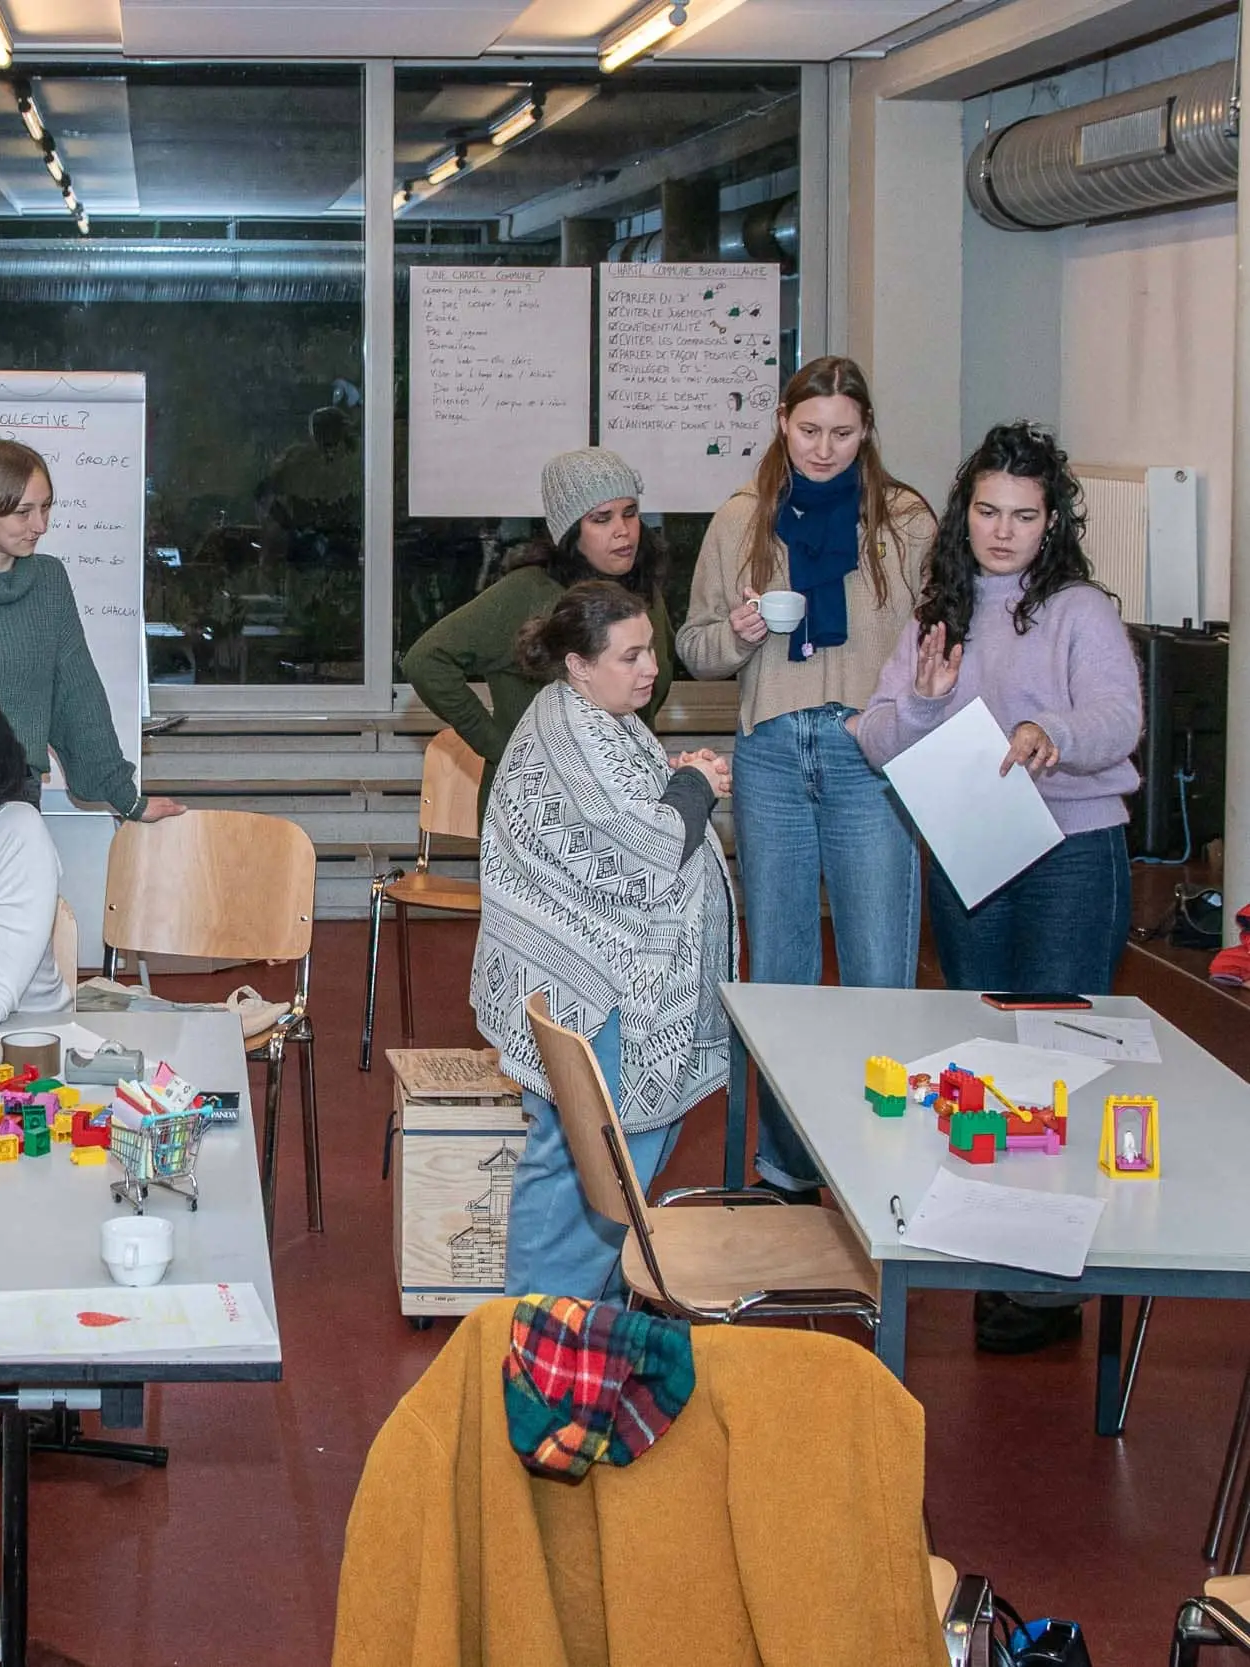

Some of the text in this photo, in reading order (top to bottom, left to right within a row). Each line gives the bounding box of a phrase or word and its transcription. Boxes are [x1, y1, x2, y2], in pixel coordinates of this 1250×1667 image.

[426, 270, 445, 281] UNE
[452, 270, 487, 281] CHARTE
[652, 264, 691, 276] COMMUNE
[699, 265, 768, 277] BIENVEILLANTE
[620, 292, 654, 304] PARLER
[652, 307, 662, 318] LE
[620, 350, 652, 361] PARLER
[75, 451, 131, 468] GROUPE
[53, 497, 88, 509] AVOIRS
[210, 1110, 238, 1120] PANDA
